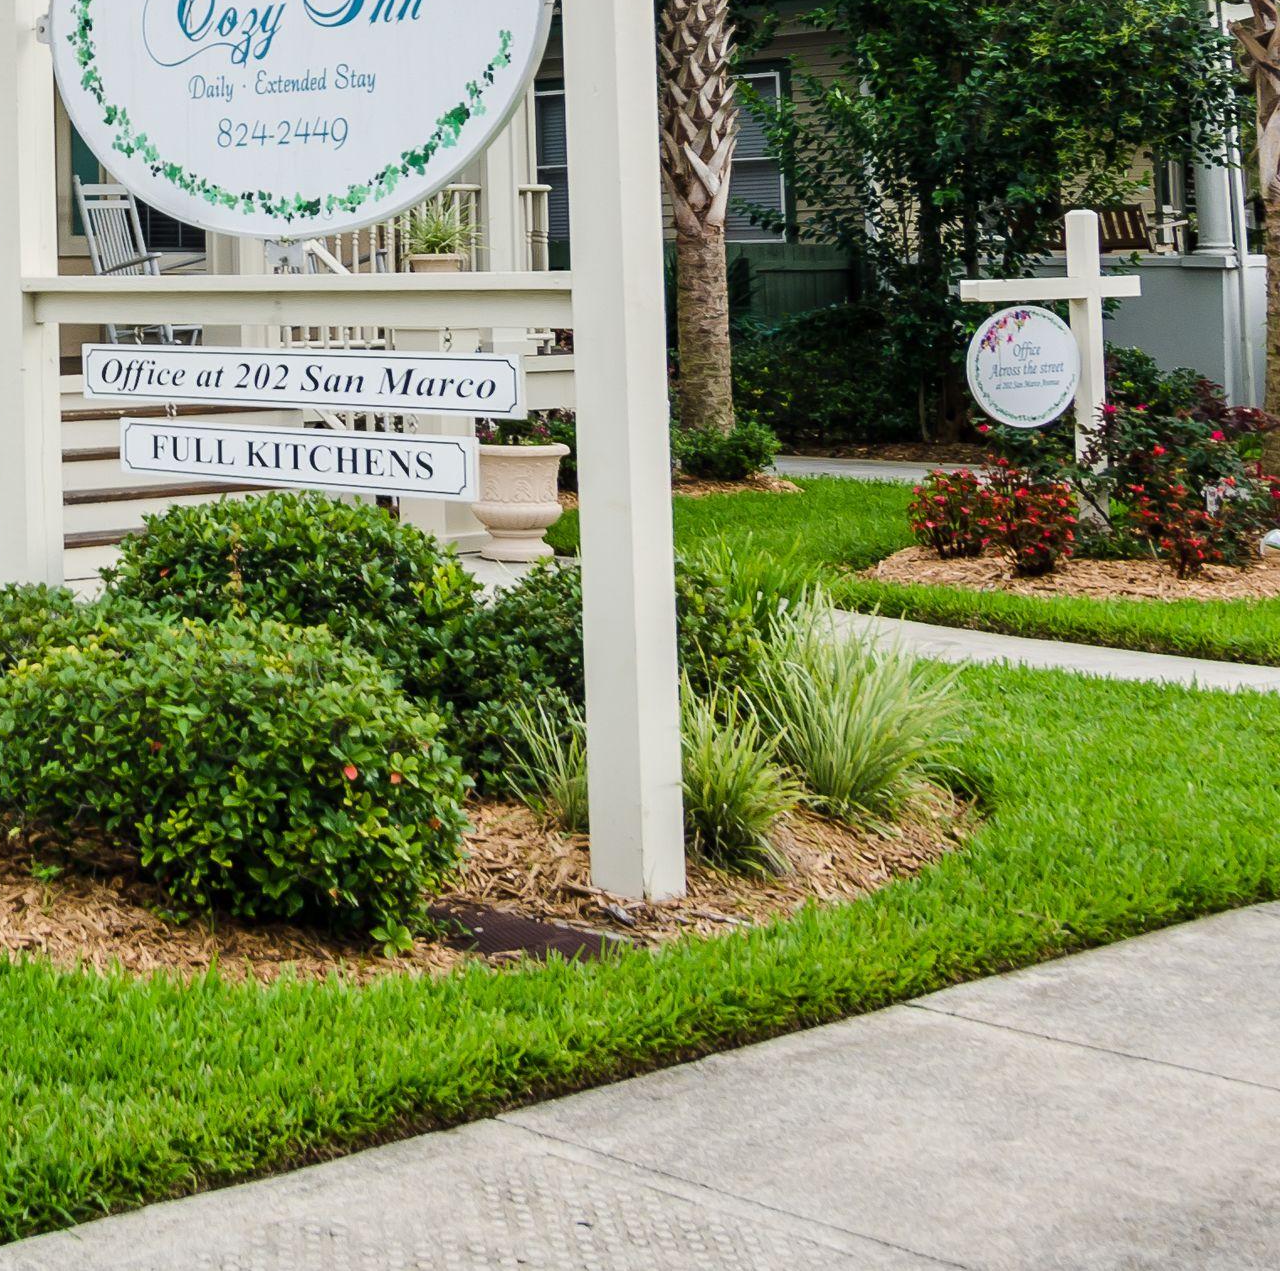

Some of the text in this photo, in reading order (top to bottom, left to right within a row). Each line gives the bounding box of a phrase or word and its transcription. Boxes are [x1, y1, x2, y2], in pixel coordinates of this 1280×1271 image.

[189, 63, 377, 103] Daily Extended Stay
[216, 116, 350, 152] 824-2449
[988, 359, 1065, 380] Across the street
[1012, 341, 1042, 362] Office
[100, 357, 498, 400] Office at 202 San Marco
[151, 432, 436, 481] FULL KITCHENS
